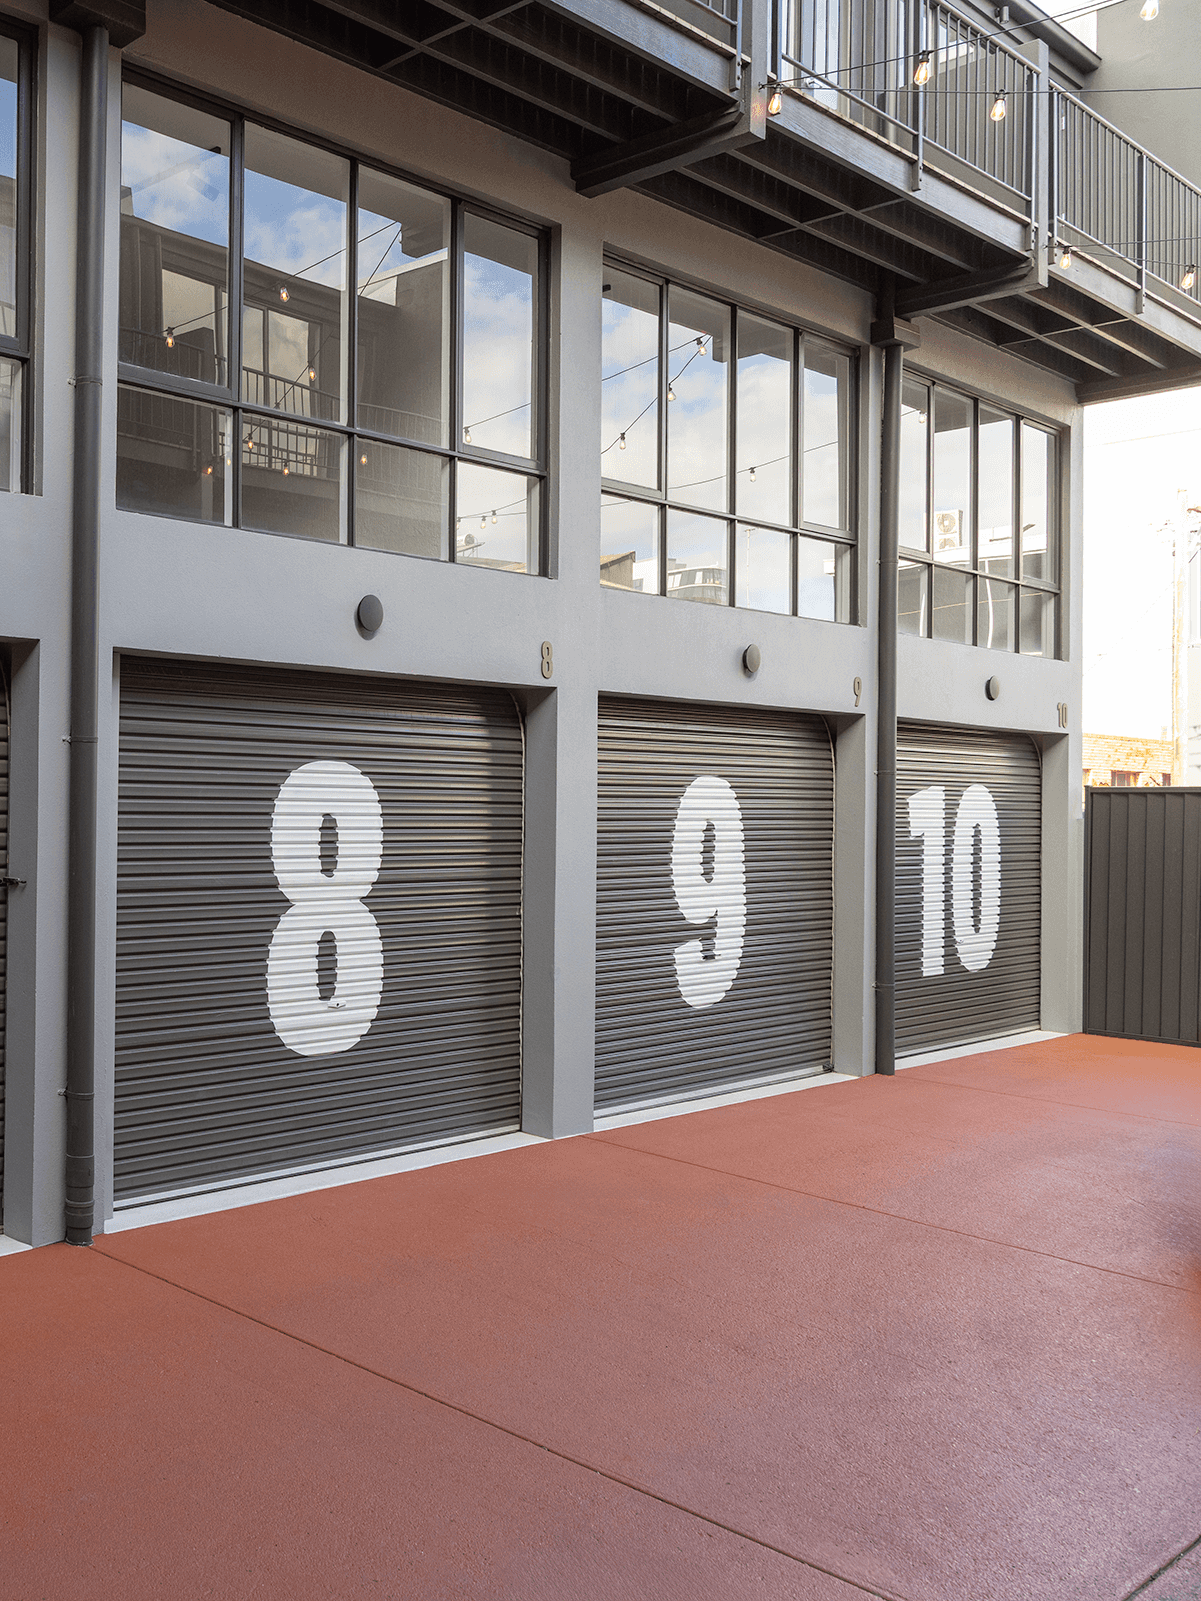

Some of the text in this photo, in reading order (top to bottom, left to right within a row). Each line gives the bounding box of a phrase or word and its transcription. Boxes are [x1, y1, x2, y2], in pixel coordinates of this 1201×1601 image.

[541, 641, 552, 679] 8
[854, 677, 862, 707] 9
[1057, 703, 1068, 728] 10
[266, 761, 384, 1056] 8
[671, 775, 746, 1008] 9
[907, 784, 1002, 976] 10
